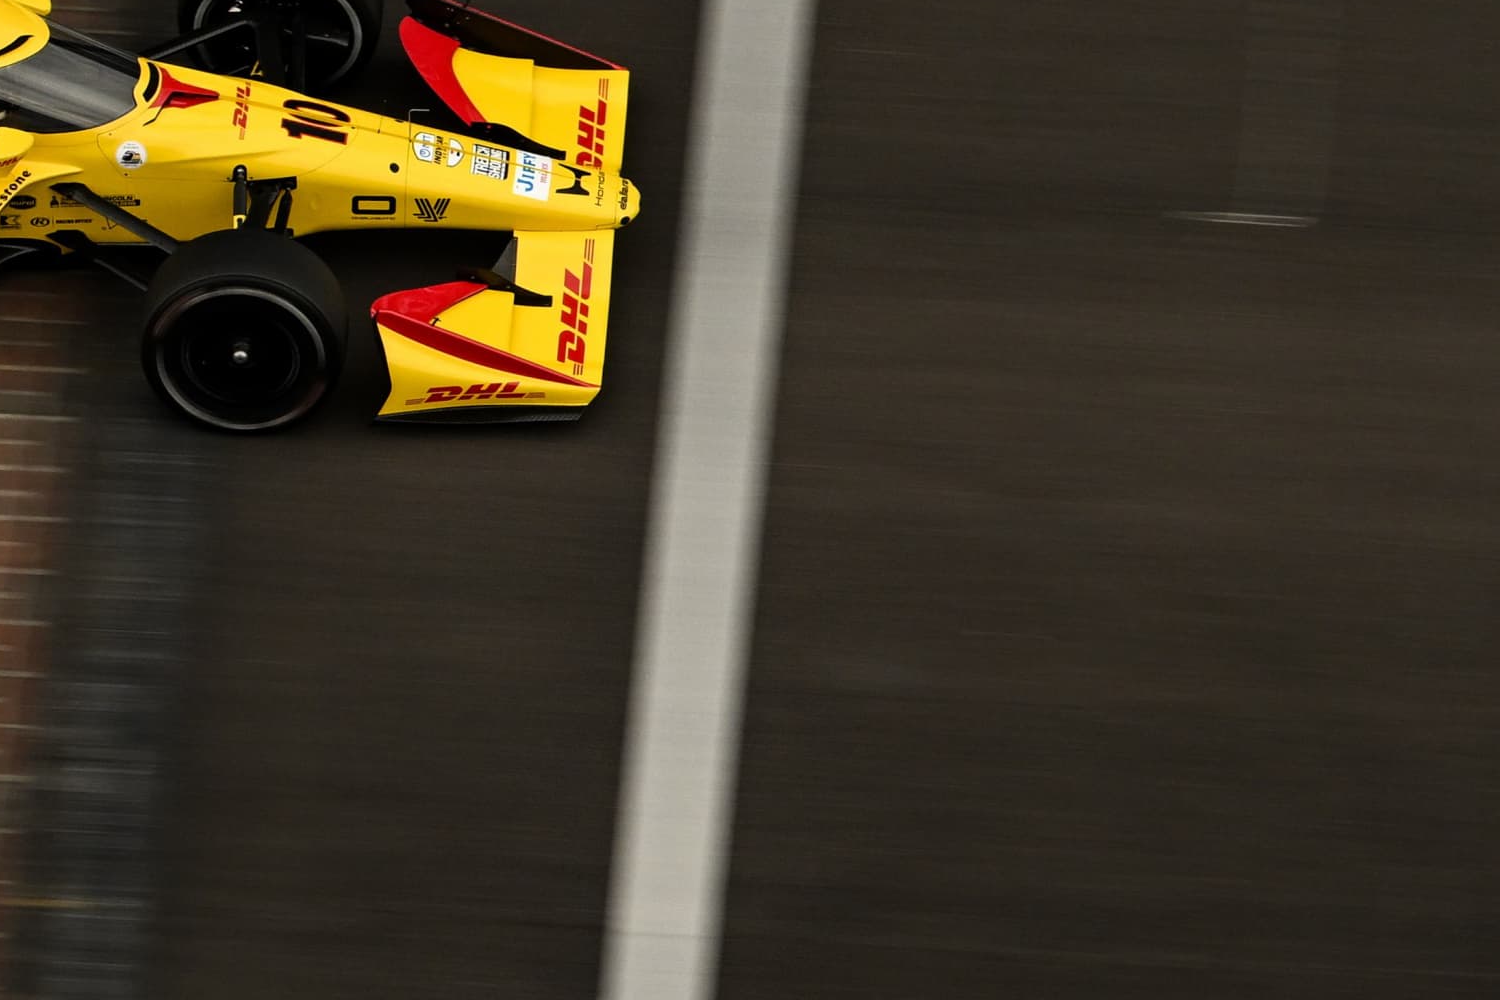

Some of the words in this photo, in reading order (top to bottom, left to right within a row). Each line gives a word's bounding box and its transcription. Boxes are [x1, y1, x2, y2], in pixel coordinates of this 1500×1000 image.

[232, 87, 251, 129] DHL
[281, 99, 351, 145] 10
[576, 98, 607, 170] DHL
[517, 153, 536, 192] JIFFY
[557, 261, 592, 364] DHL
[424, 382, 526, 403] DHL
